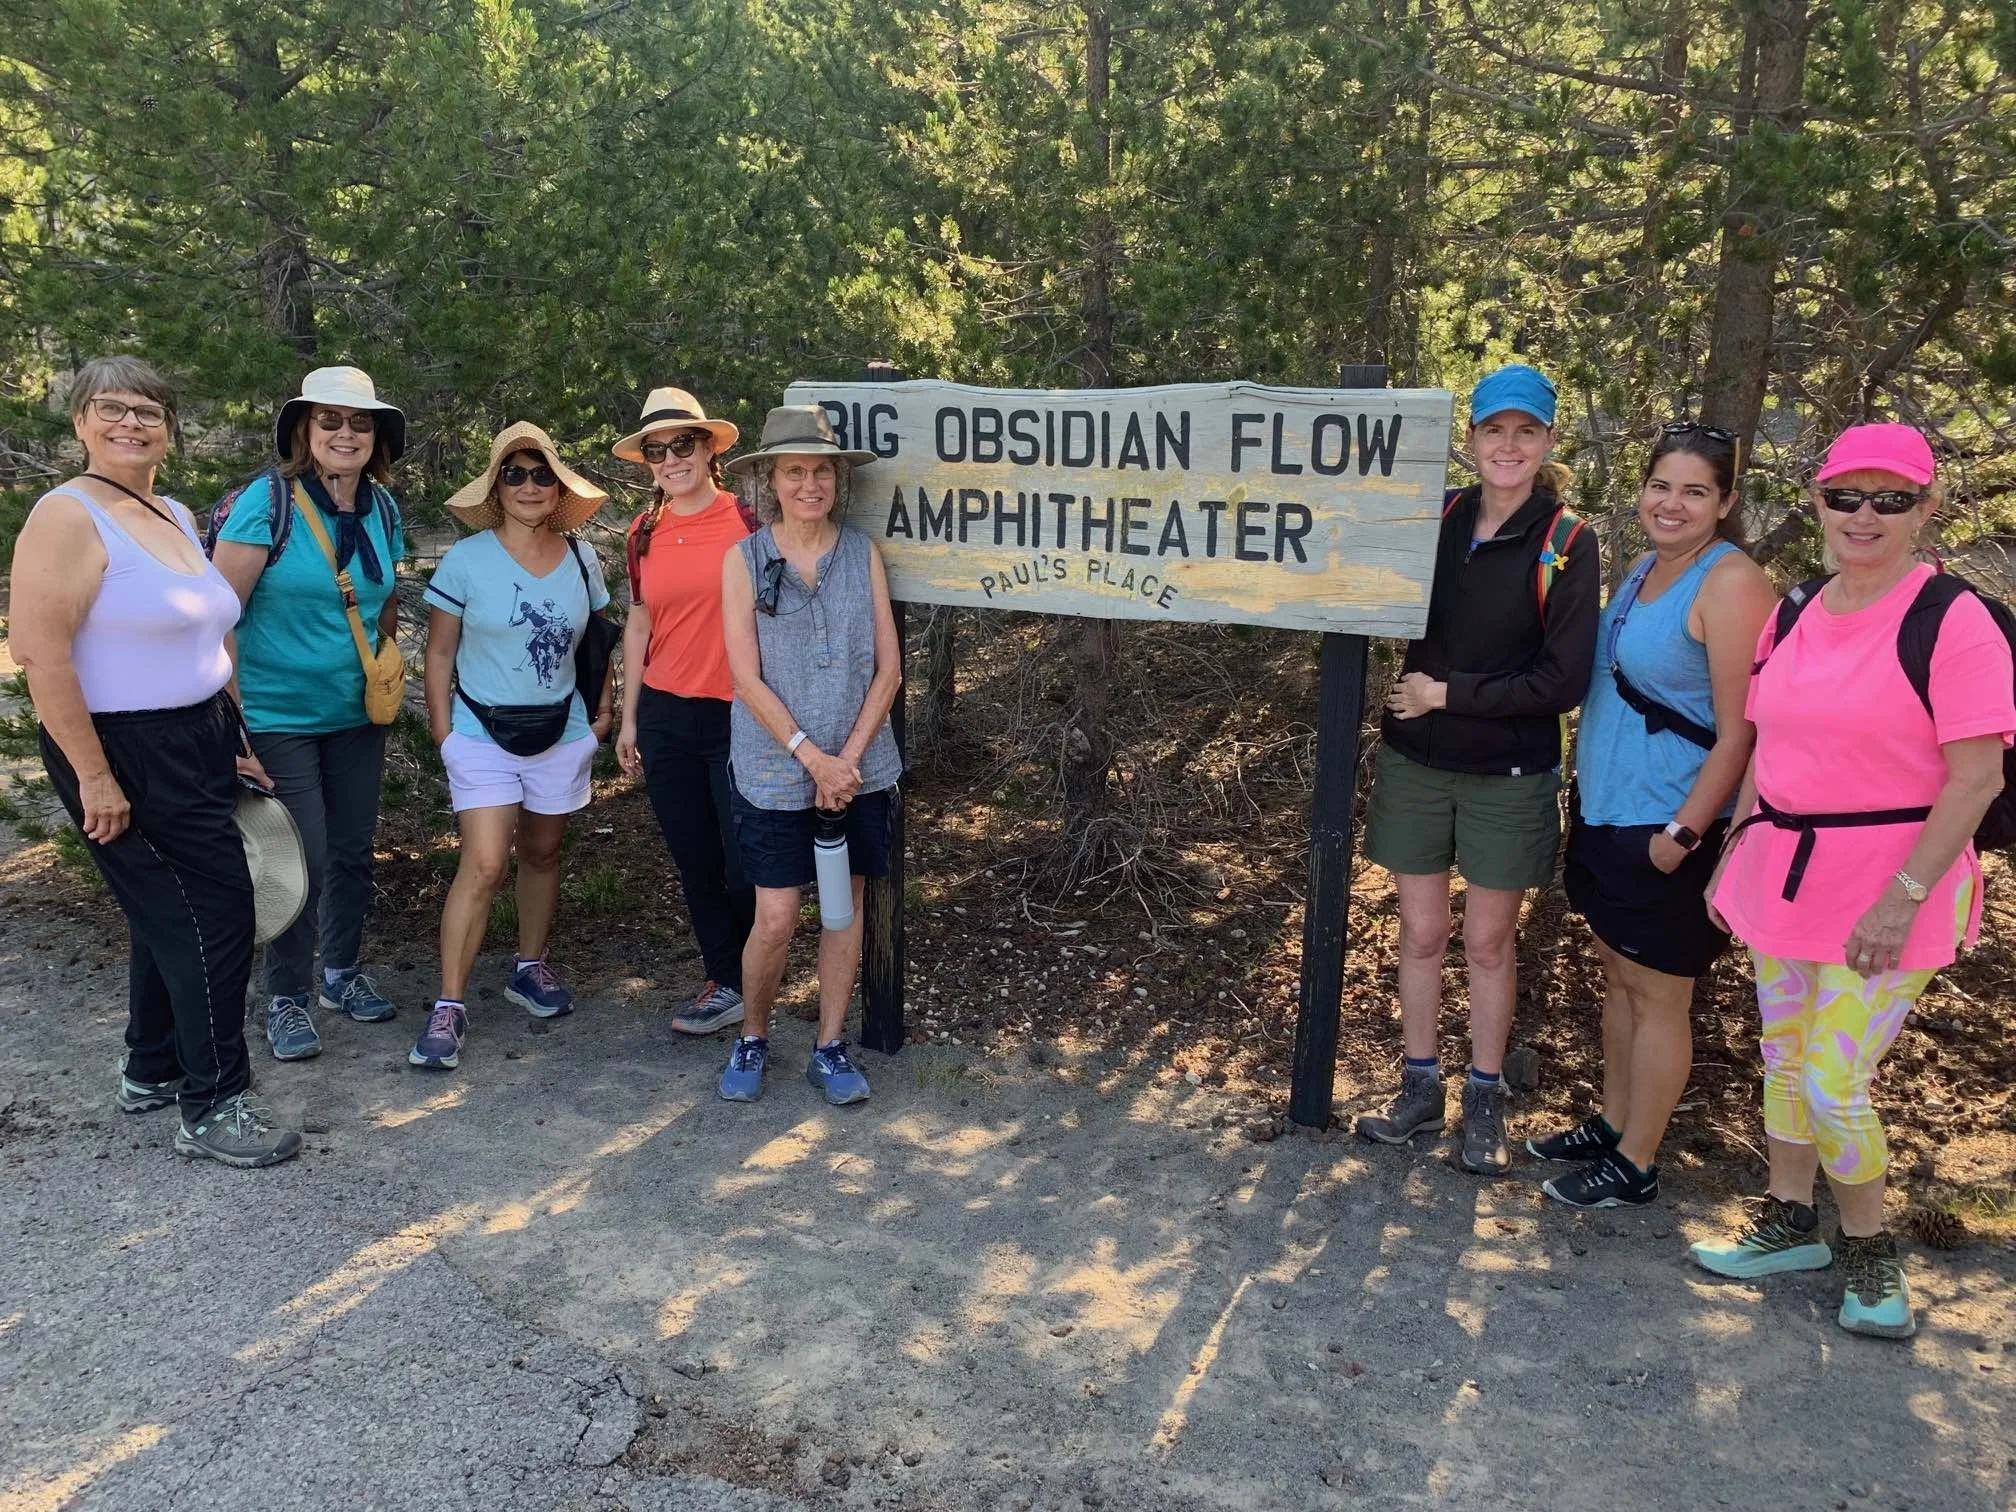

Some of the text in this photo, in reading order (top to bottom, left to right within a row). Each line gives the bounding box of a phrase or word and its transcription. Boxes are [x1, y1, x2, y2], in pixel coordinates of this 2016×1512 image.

[818, 400, 1403, 477] BIG OBSIDIAN FLOW
[885, 485, 1313, 563] AMPHITHEATER
[979, 554, 1178, 610] PAUL'S PLACE
